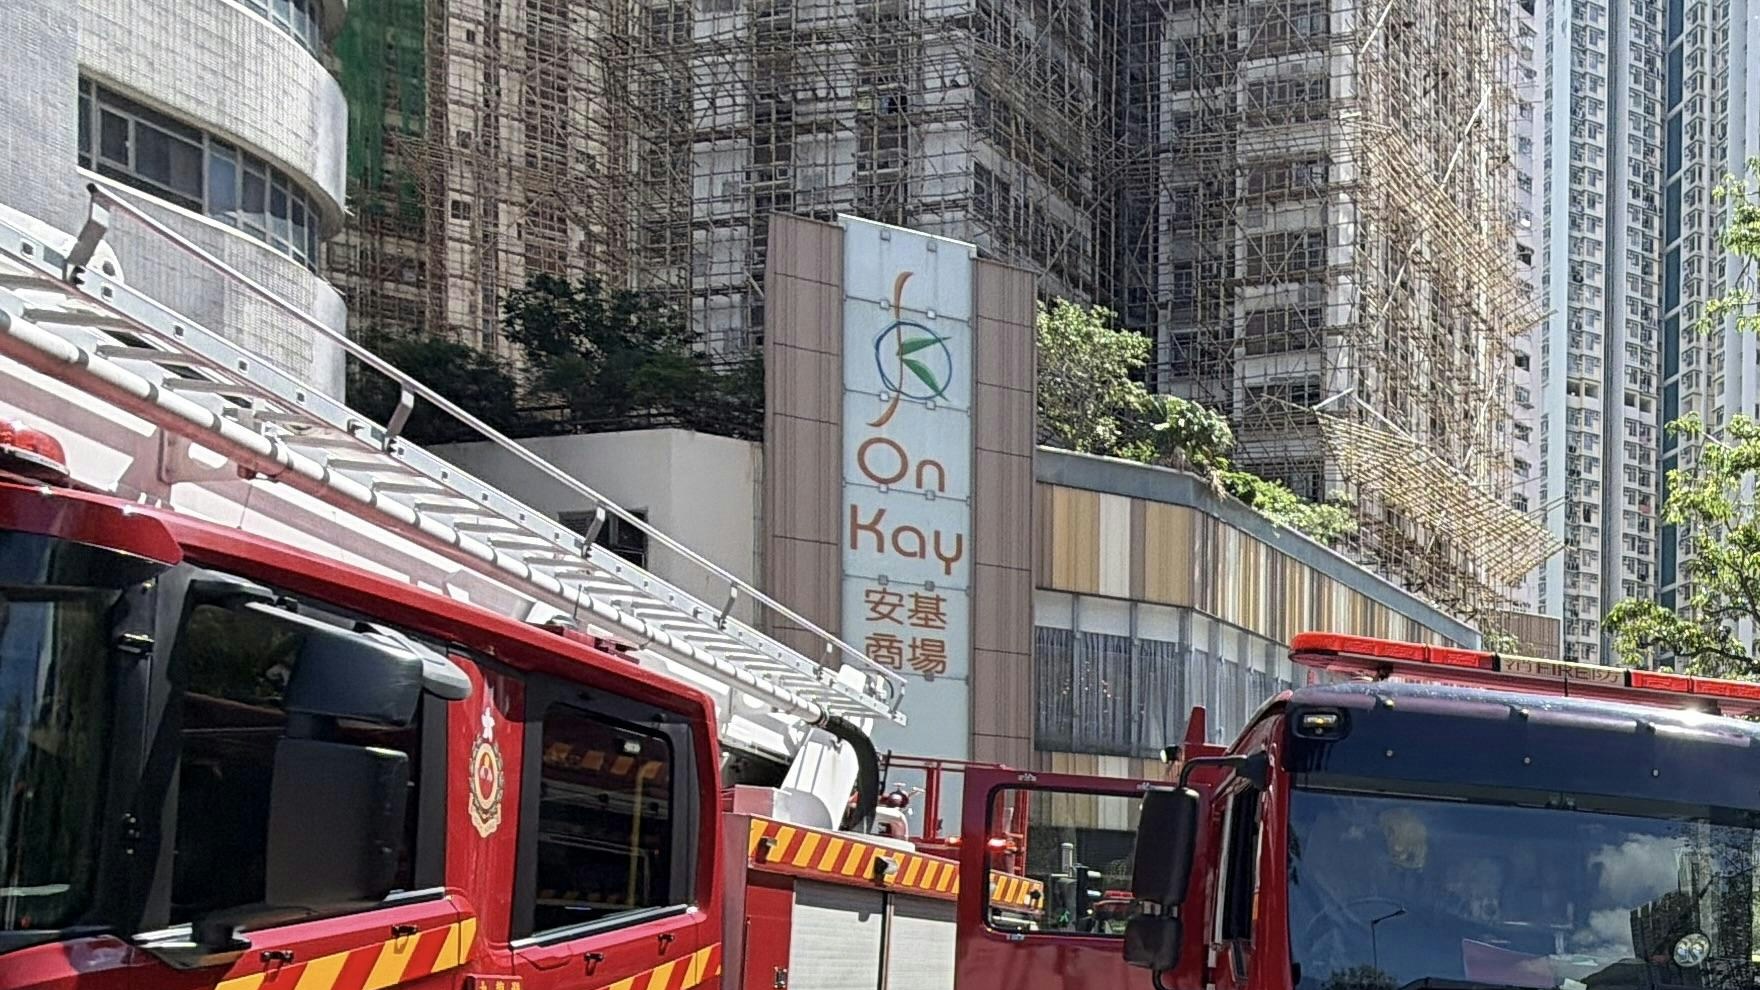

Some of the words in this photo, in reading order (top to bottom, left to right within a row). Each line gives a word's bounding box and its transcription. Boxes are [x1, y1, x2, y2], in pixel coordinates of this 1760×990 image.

[857, 437, 945, 493] On
[850, 503, 963, 576] Kay
[864, 587, 947, 630] 安基
[864, 632, 947, 675] 商場
[1536, 662, 1589, 680] FIRE
